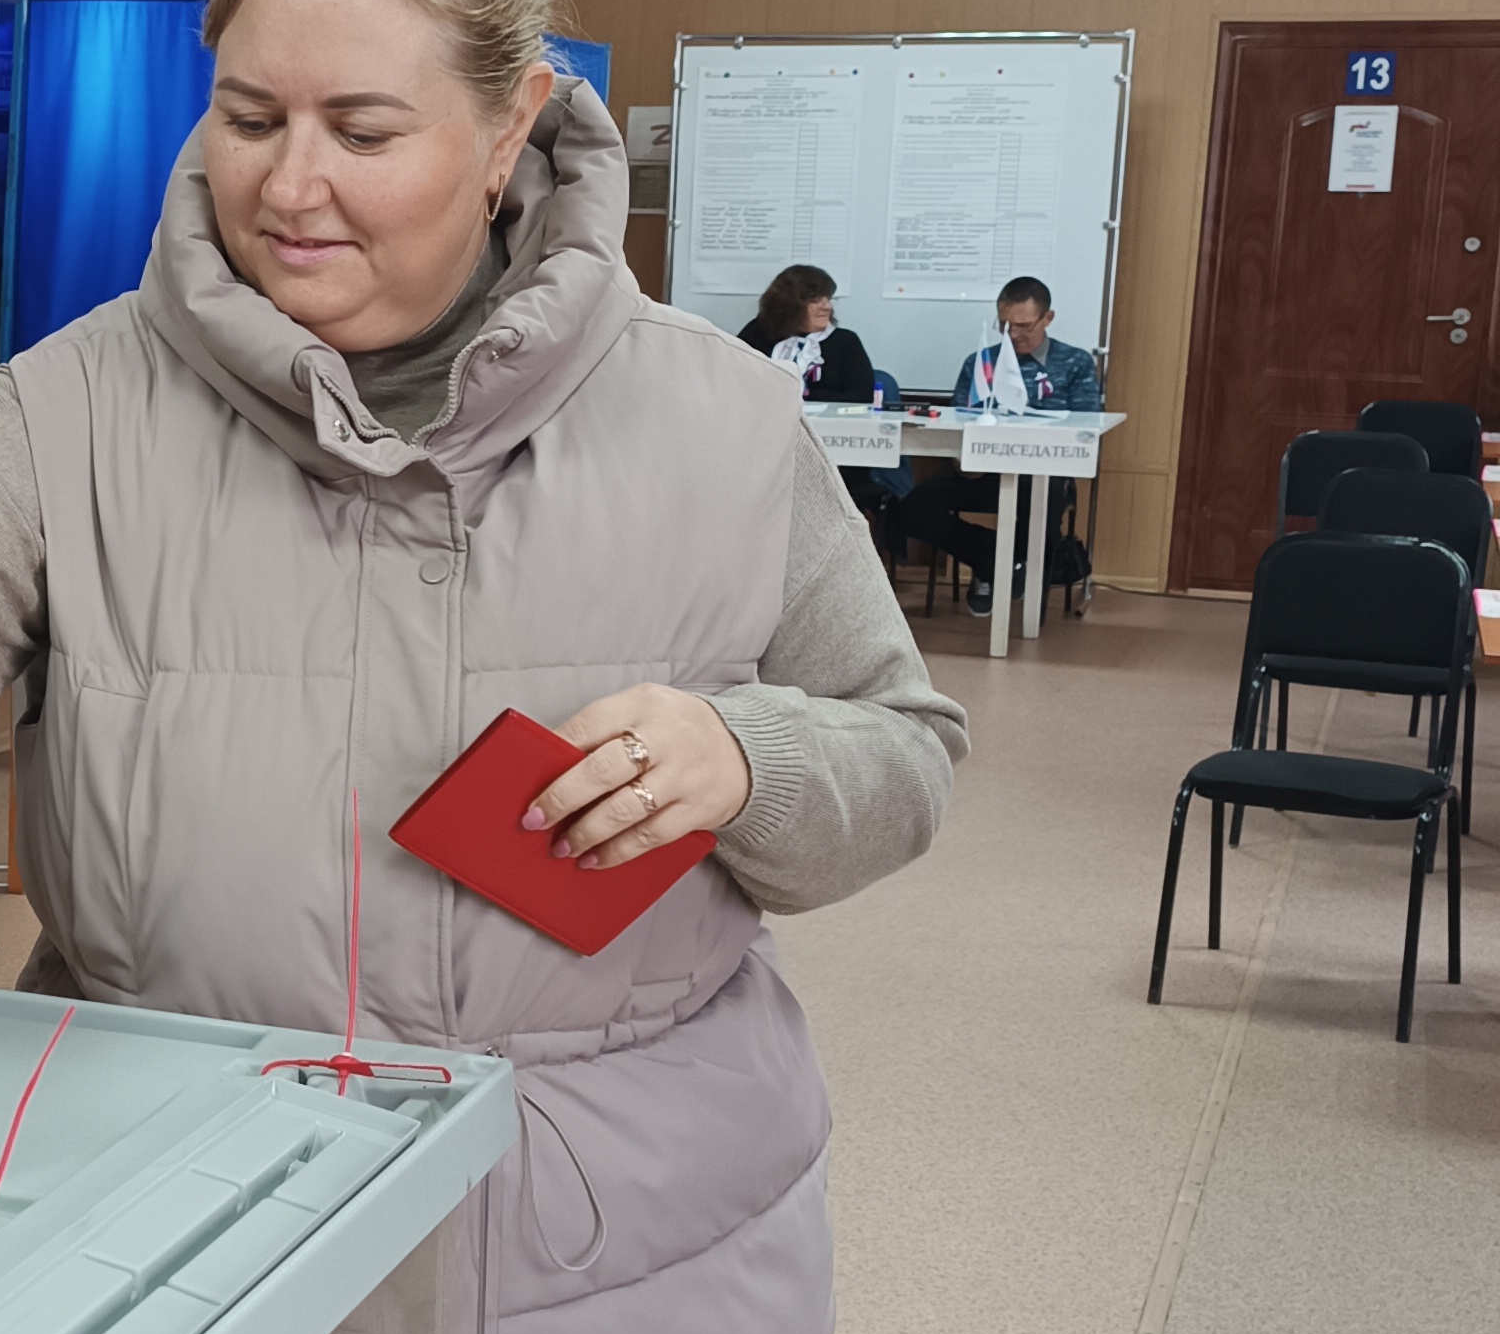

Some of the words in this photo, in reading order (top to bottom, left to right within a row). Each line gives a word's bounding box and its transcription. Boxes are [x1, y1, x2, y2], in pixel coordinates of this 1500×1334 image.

[1350, 56, 1391, 91] 13
[820, 435, 895, 450] ЕКРЕТАРЬ
[970, 441, 1091, 459] ПРЕДСЕДАТЕЛЬ
